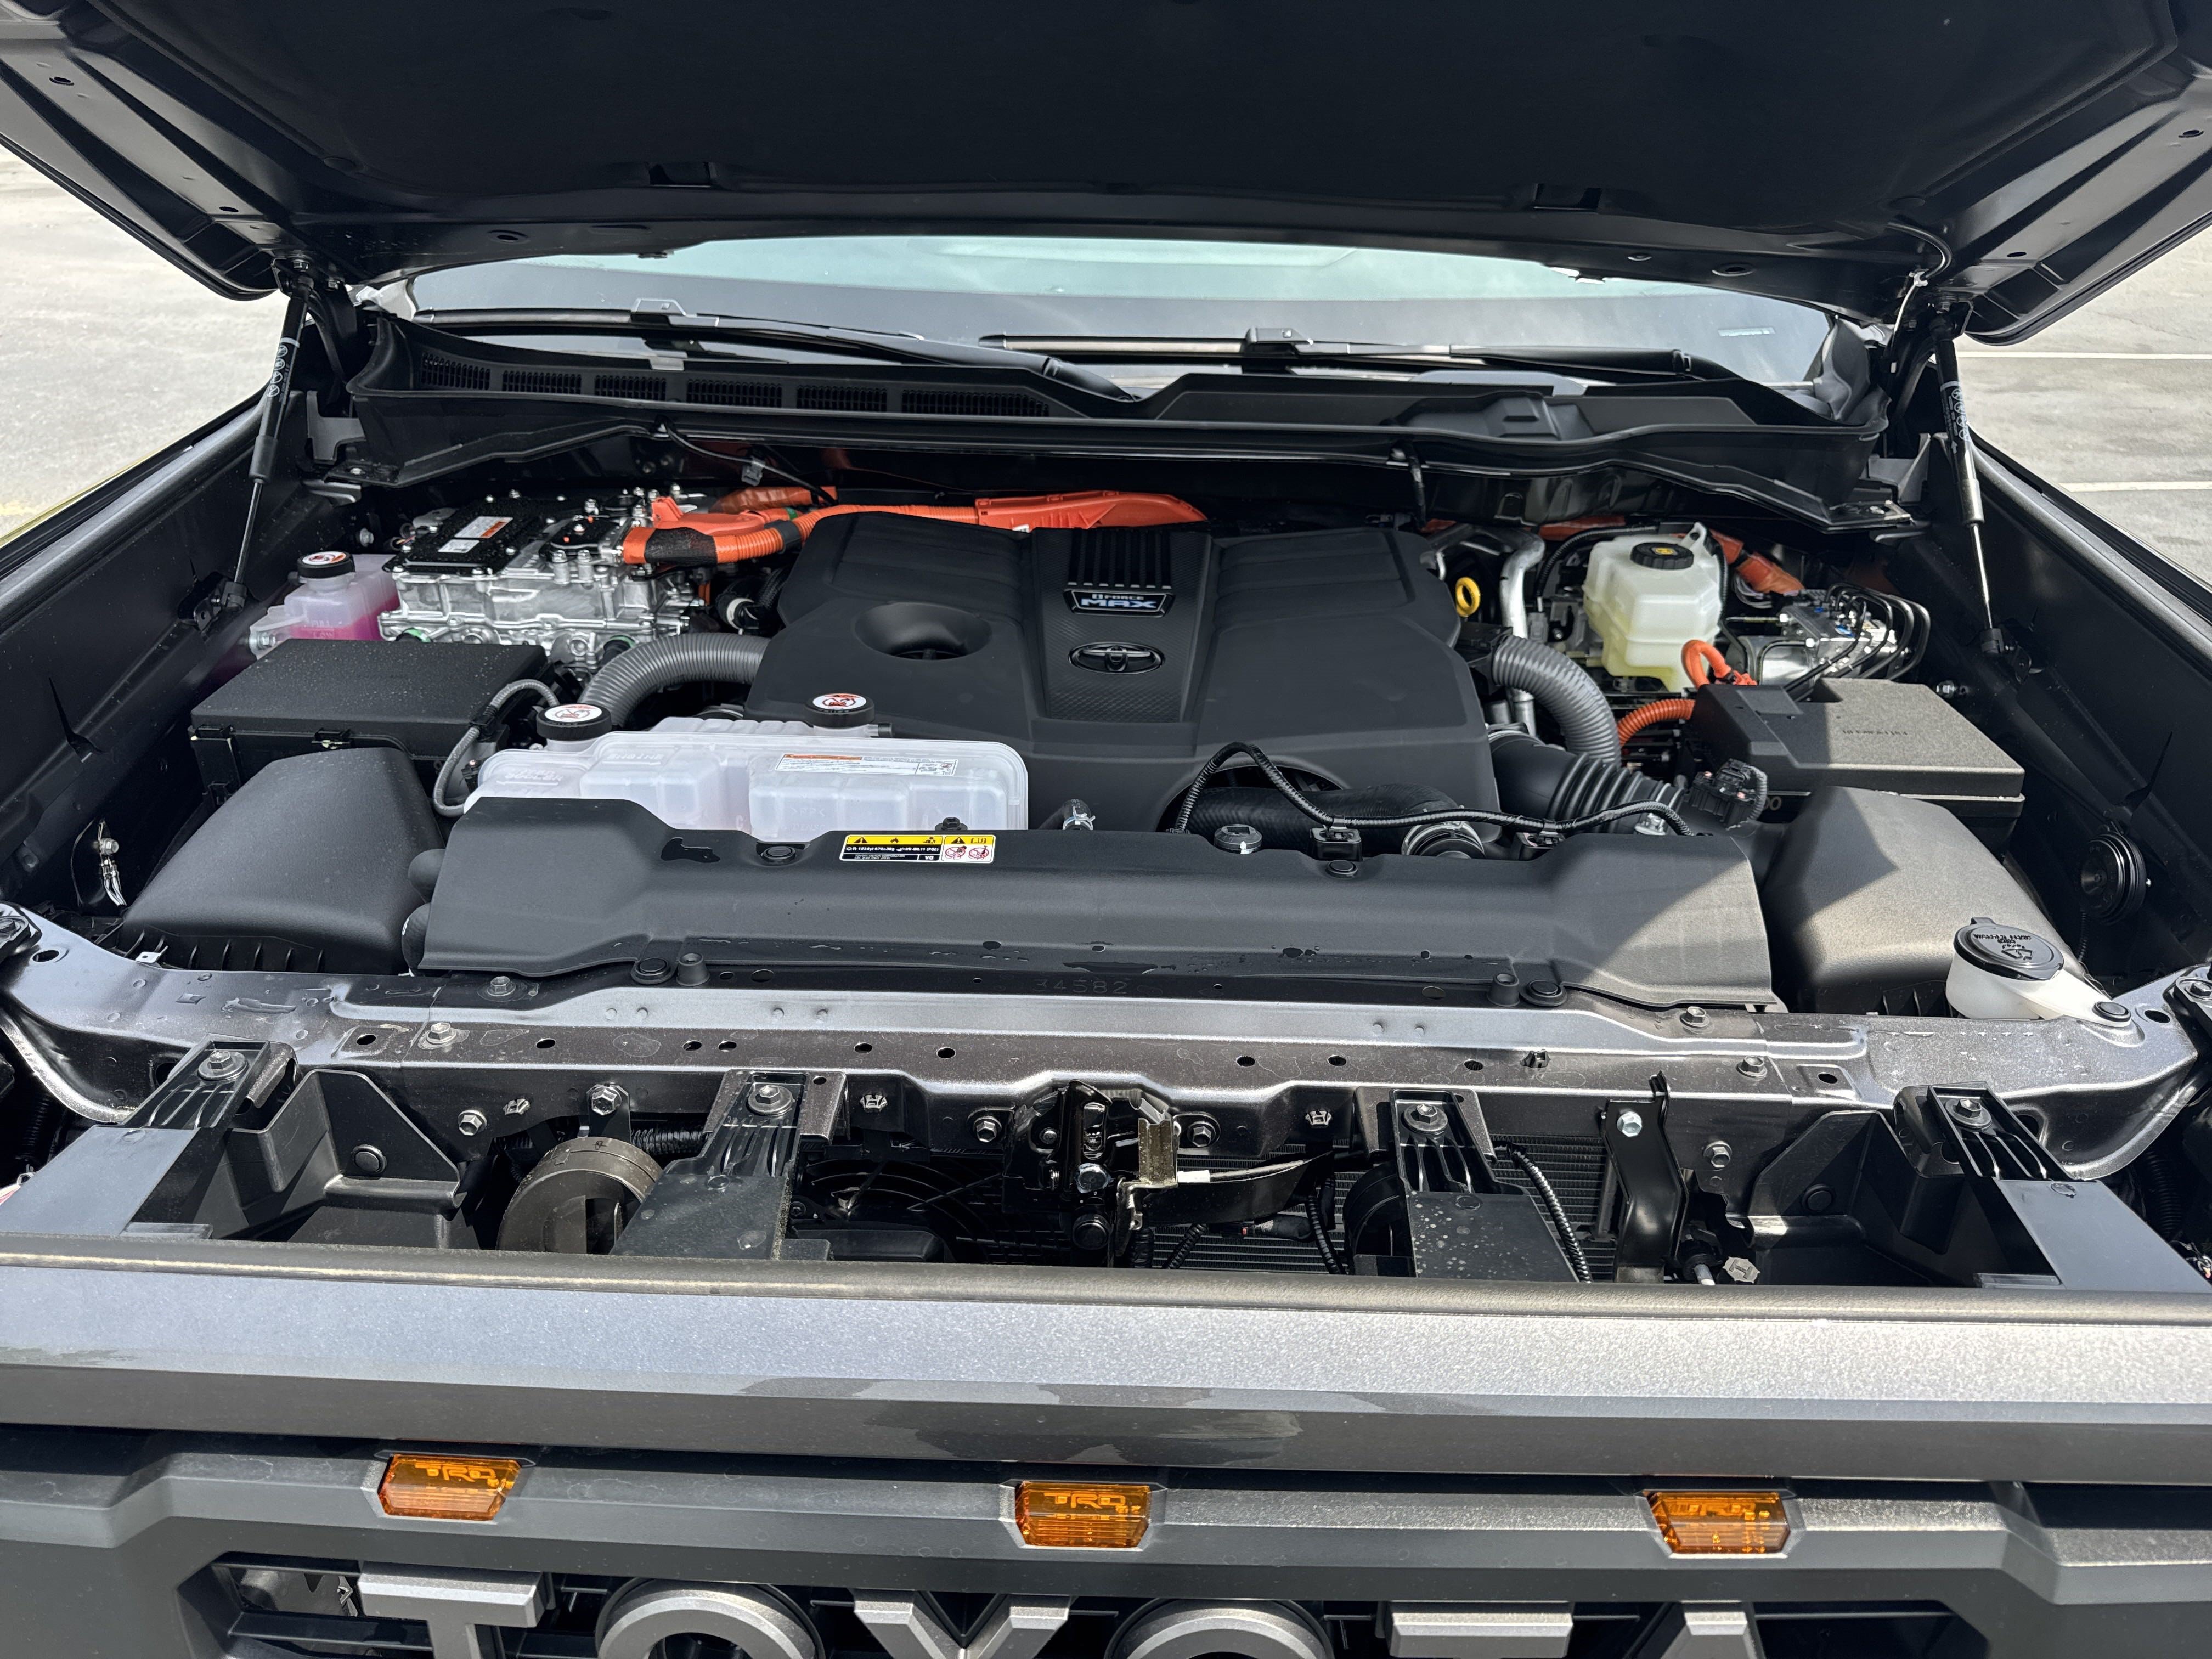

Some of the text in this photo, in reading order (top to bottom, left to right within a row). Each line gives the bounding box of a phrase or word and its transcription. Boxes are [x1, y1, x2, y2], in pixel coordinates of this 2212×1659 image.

[1081, 599, 1157, 608] MAX
[1032, 979, 1128, 994] 34582
[415, 1463, 497, 1482] TRD
[1043, 1493, 1127, 1509] TRD
